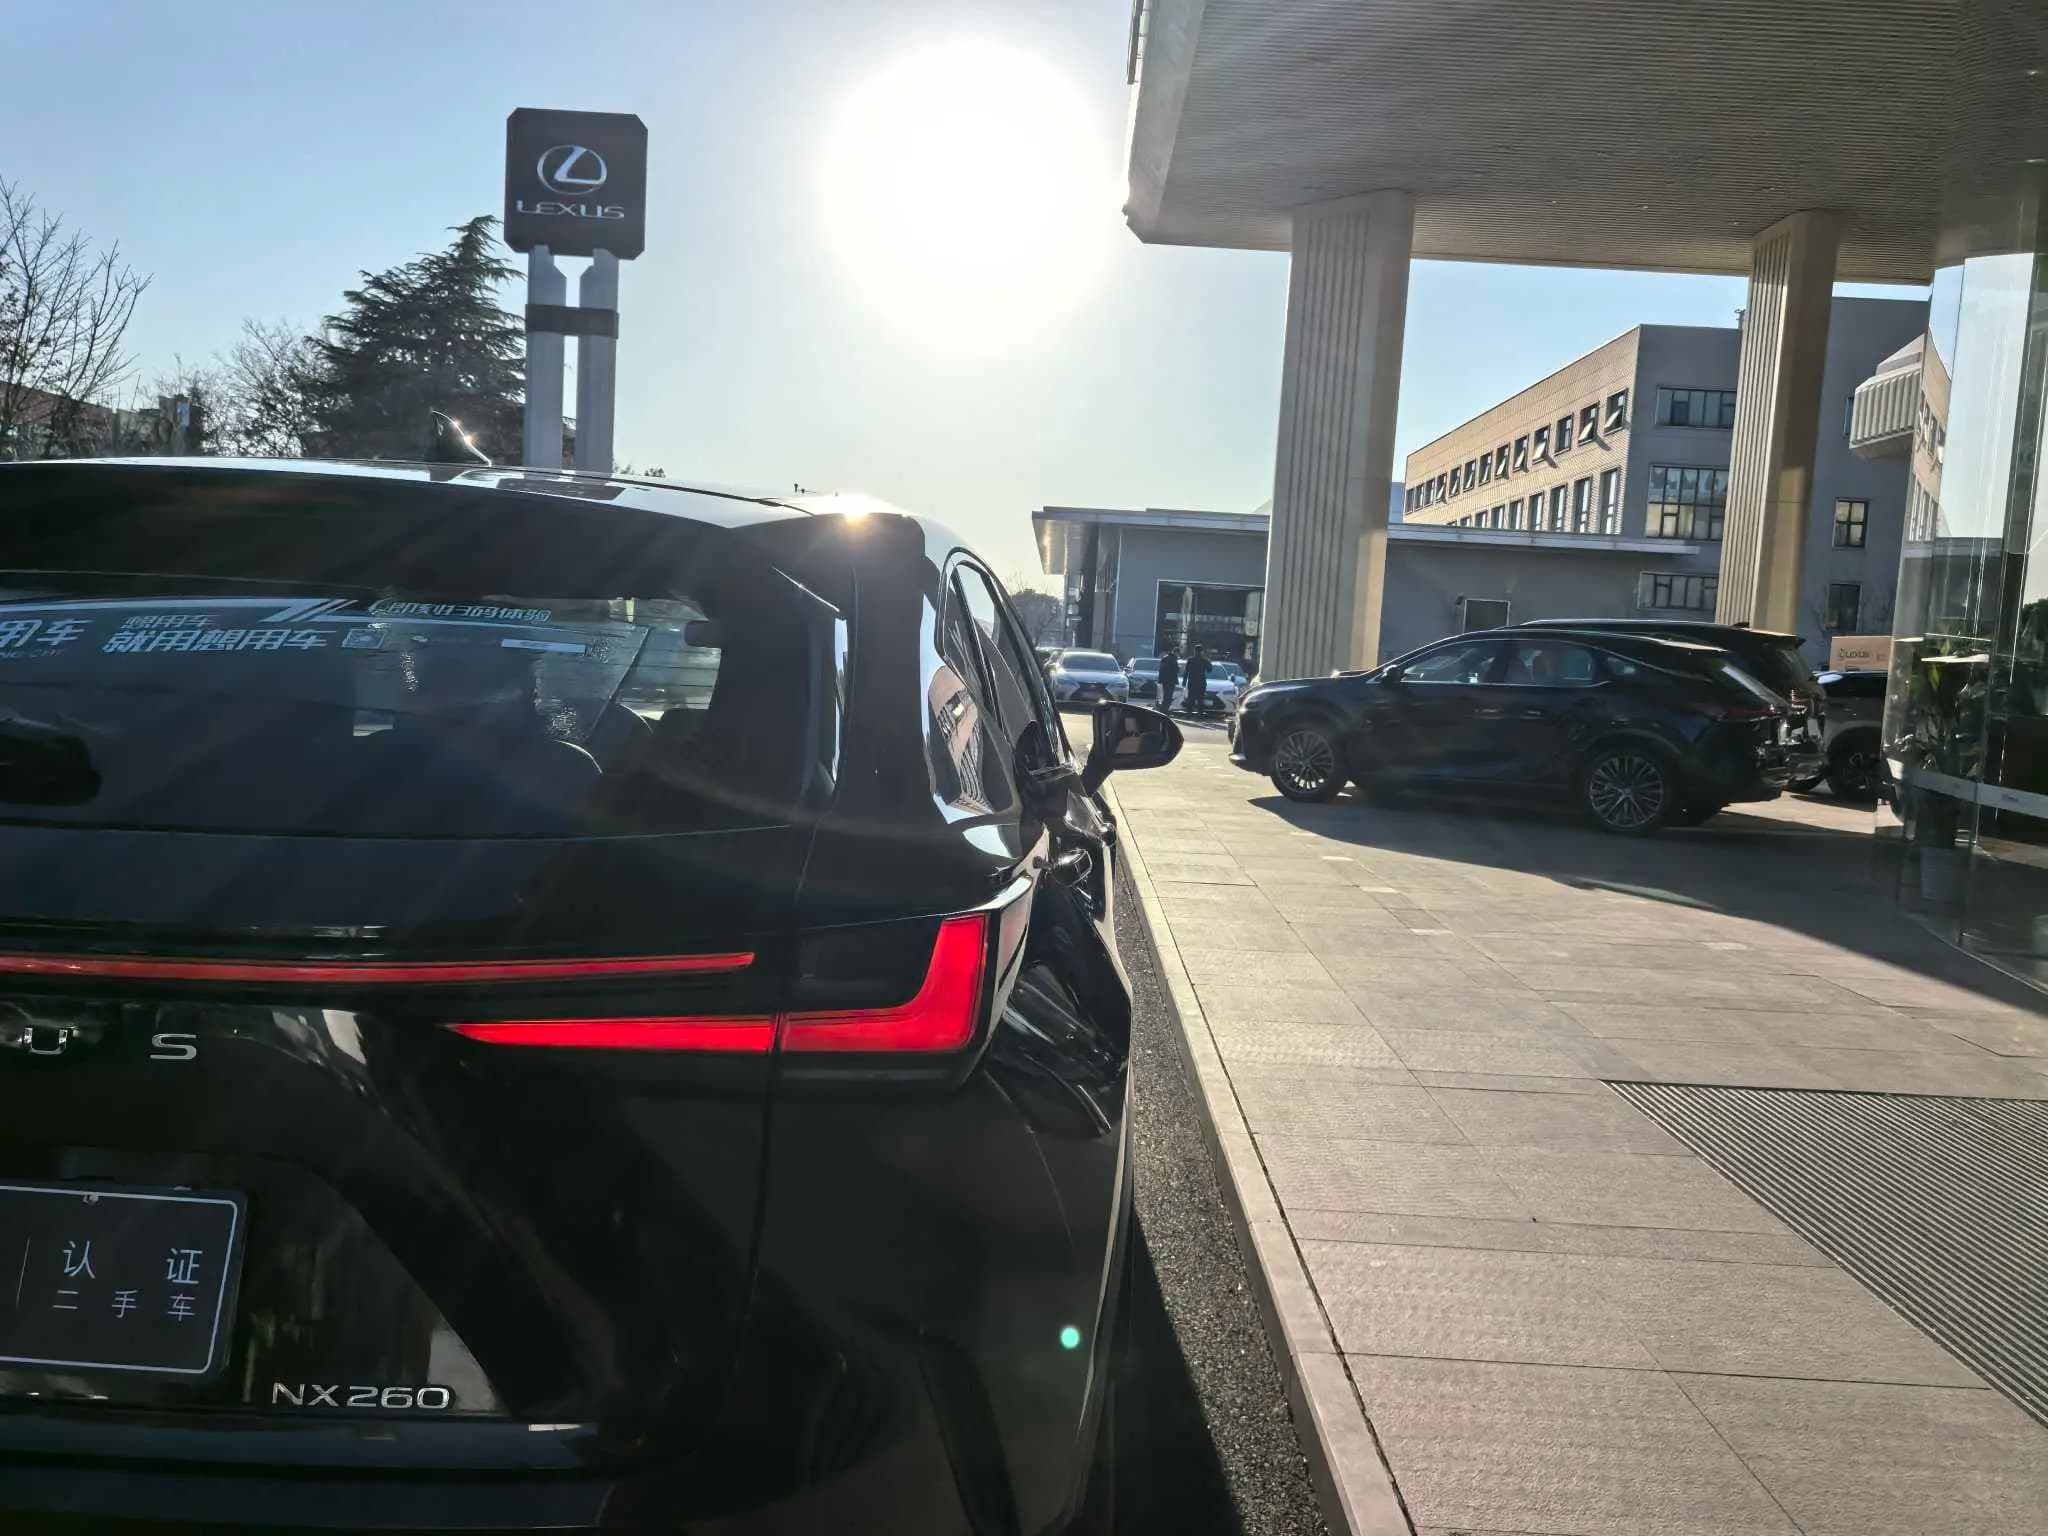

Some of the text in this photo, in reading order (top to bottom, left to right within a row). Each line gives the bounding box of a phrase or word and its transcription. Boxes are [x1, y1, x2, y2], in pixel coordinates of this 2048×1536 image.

[517, 199, 625, 219] LEXUS
[102, 629, 337, 653] 就用想用车
[62, 1240, 203, 1284] 认证
[52, 1290, 196, 1321] 二手车
[271, 1382, 450, 1409] NX260
